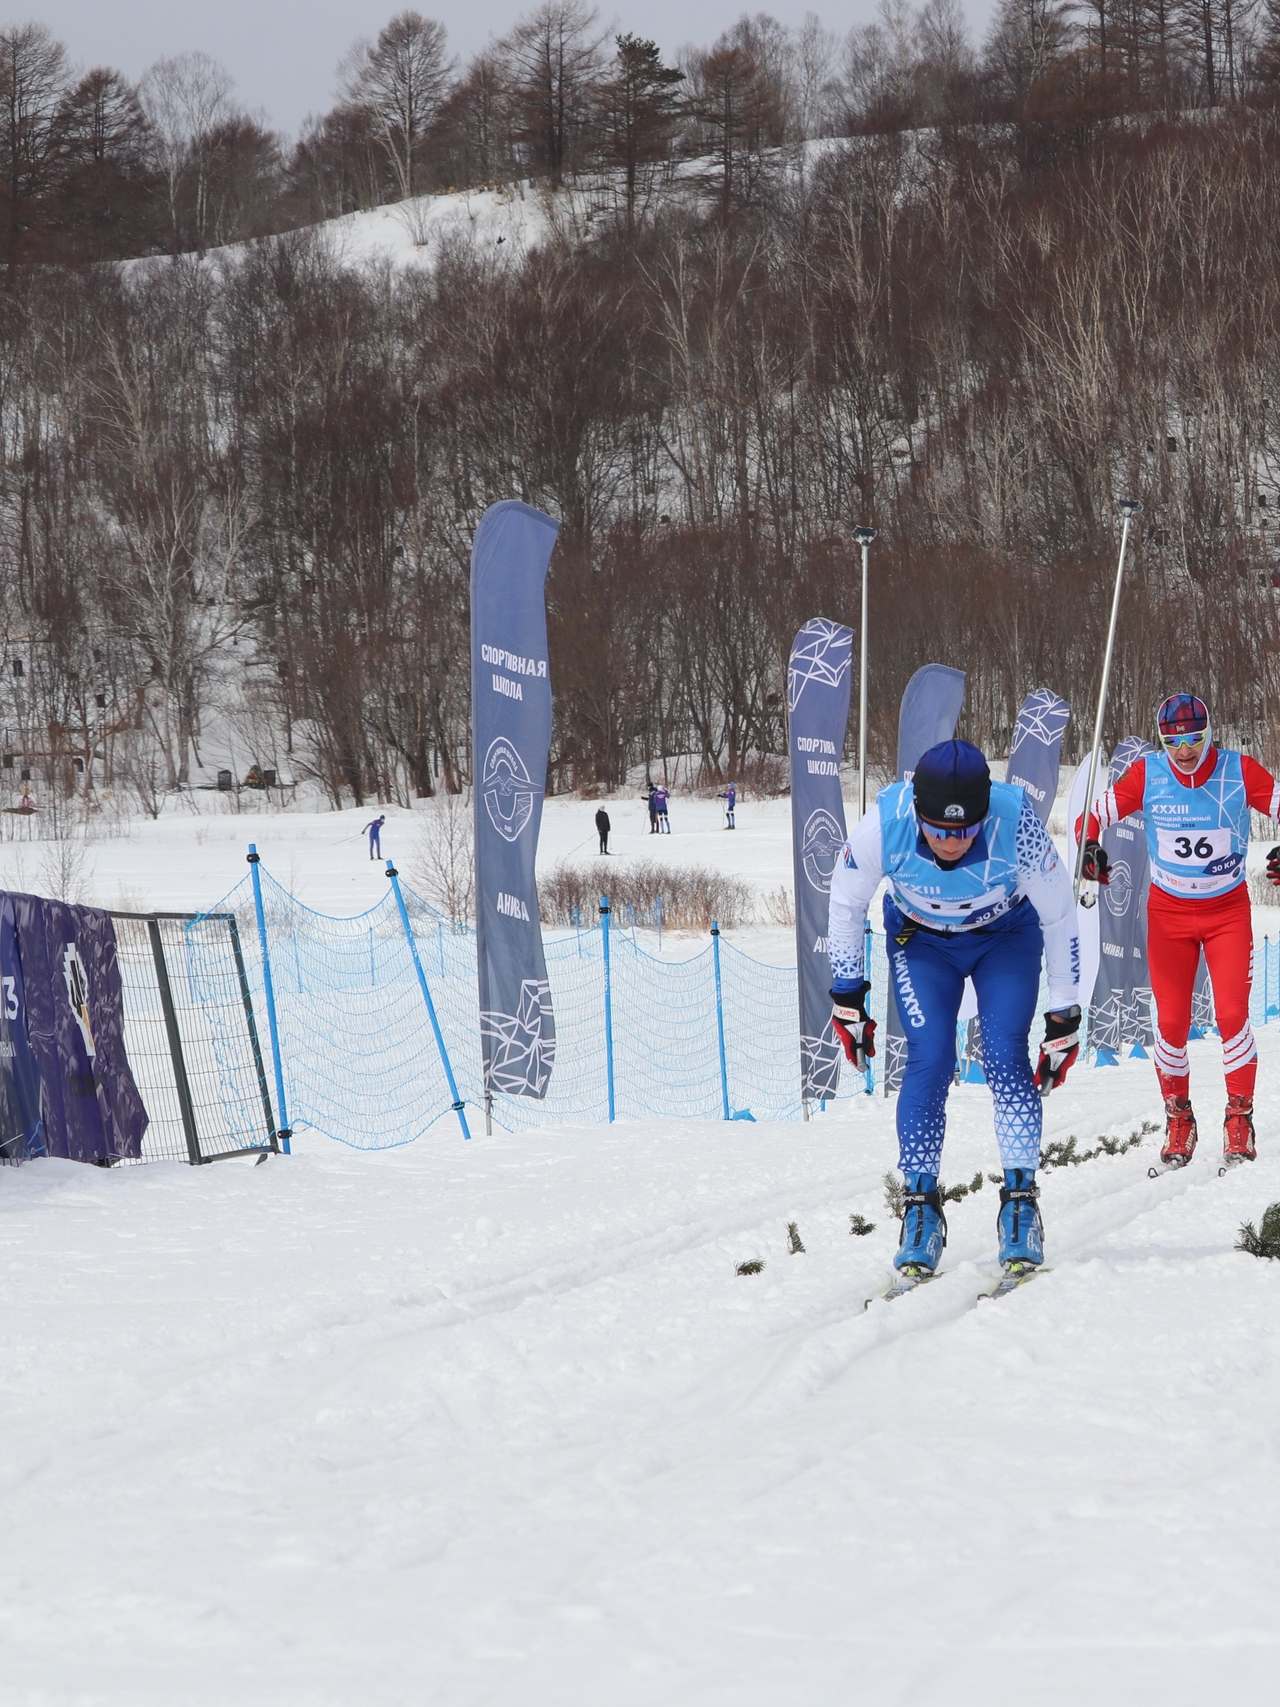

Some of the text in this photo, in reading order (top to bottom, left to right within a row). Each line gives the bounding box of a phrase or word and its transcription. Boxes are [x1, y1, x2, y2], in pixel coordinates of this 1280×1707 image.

[481, 643, 547, 678] СПОРТИВНАЯ
[492, 674, 523, 701] ШКОЛА
[807, 759, 839, 777] ШКОЛА
[1151, 804, 1189, 814] XXXIII
[1182, 814, 1212, 822] ЛЫЖНЫЙ
[1174, 837, 1214, 859] 36
[1212, 858, 1236, 873] 30 КМ
[496, 892, 530, 922] АНИВА
[892, 949, 926, 1028] САХАЛИН
[1009, 1191, 1037, 1199] SPIN
